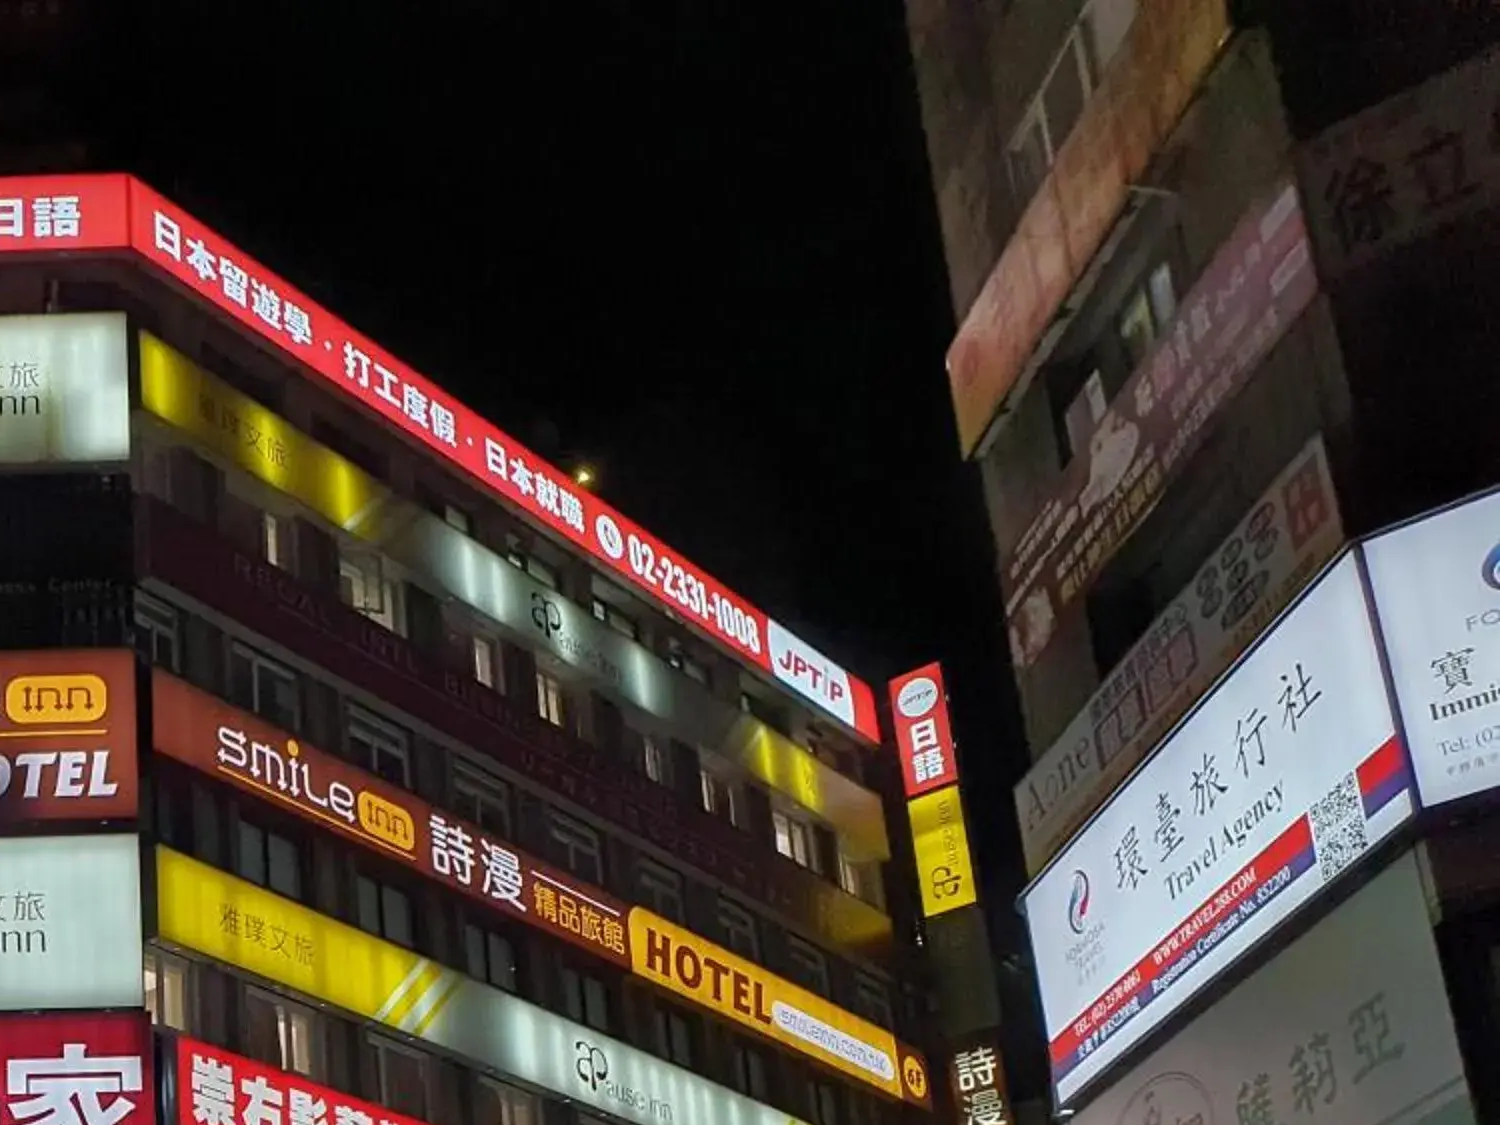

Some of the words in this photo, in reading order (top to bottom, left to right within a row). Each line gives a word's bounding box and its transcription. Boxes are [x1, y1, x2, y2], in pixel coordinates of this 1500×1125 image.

[154, 210, 312, 345] 日本留遊學
[343, 341, 457, 448] 打工度假
[485, 437, 585, 534] 日本就職
[628, 533, 762, 655] 02-2331-1008
[22, 685, 95, 712] inn
[1430, 647, 1476, 694] 寶
[217, 725, 357, 824] smile
[910, 717, 946, 784] 日語
[1112, 663, 1323, 894] 環臺旅行社
[429, 813, 527, 912] 詩漫
[1163, 835, 1218, 901] Travel
[1221, 779, 1284, 855] Agency
[533, 880, 627, 957] 精品旅館
[645, 927, 773, 1025] HOTEL
